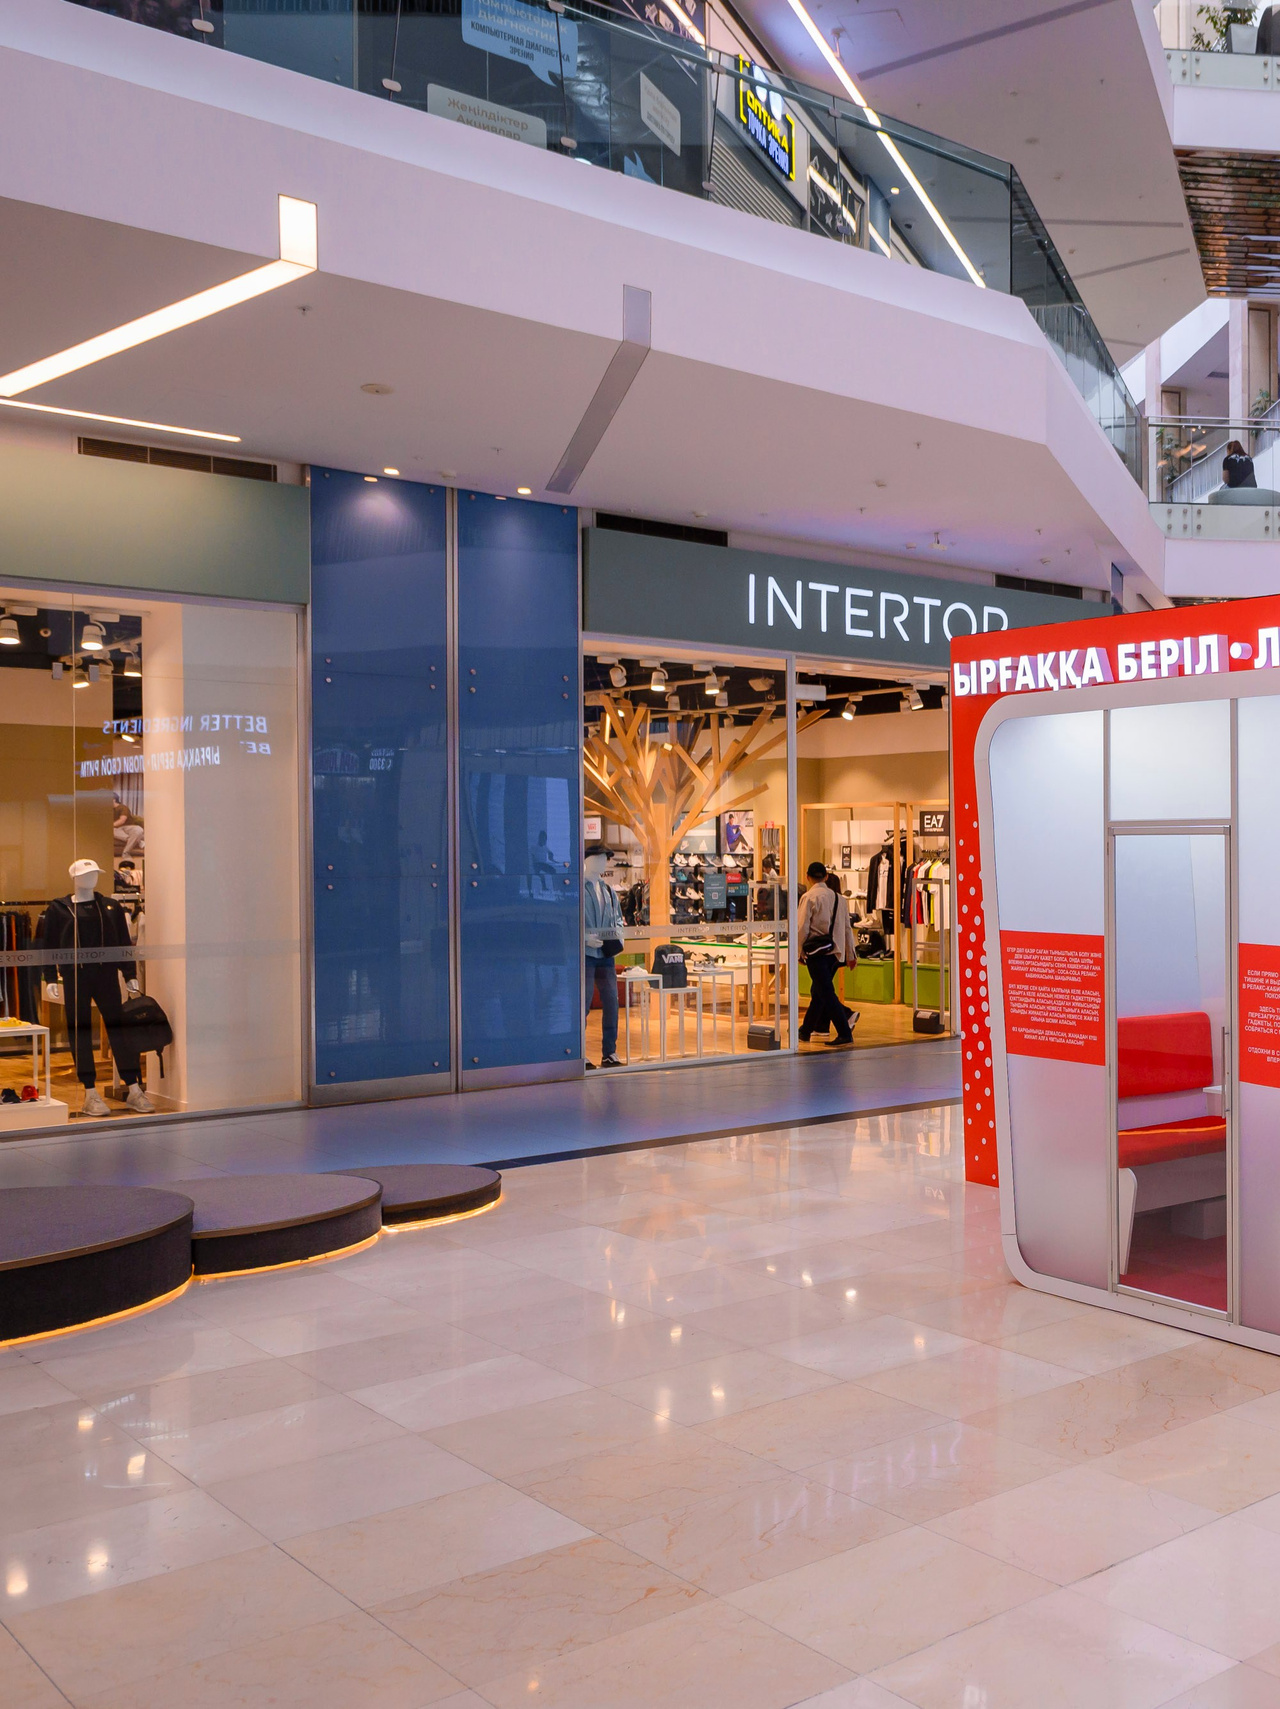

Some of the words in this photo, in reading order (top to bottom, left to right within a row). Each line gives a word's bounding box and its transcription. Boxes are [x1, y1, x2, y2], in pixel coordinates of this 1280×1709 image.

[471, 20, 525, 46] КОМПЬЮТЕРНАЯ
[525, 41, 570, 62] ДИАГНОСТКА
[509, 46, 535, 61] ЗРЕНИЯ
[747, 89, 789, 153] ОПТИКА
[953, 646, 1105, 697] ЫРҒАҚҚА
[1117, 633, 1223, 683] БЕРІЛ
[924, 814, 944, 828] EA7
[662, 953, 684, 964] VANS
